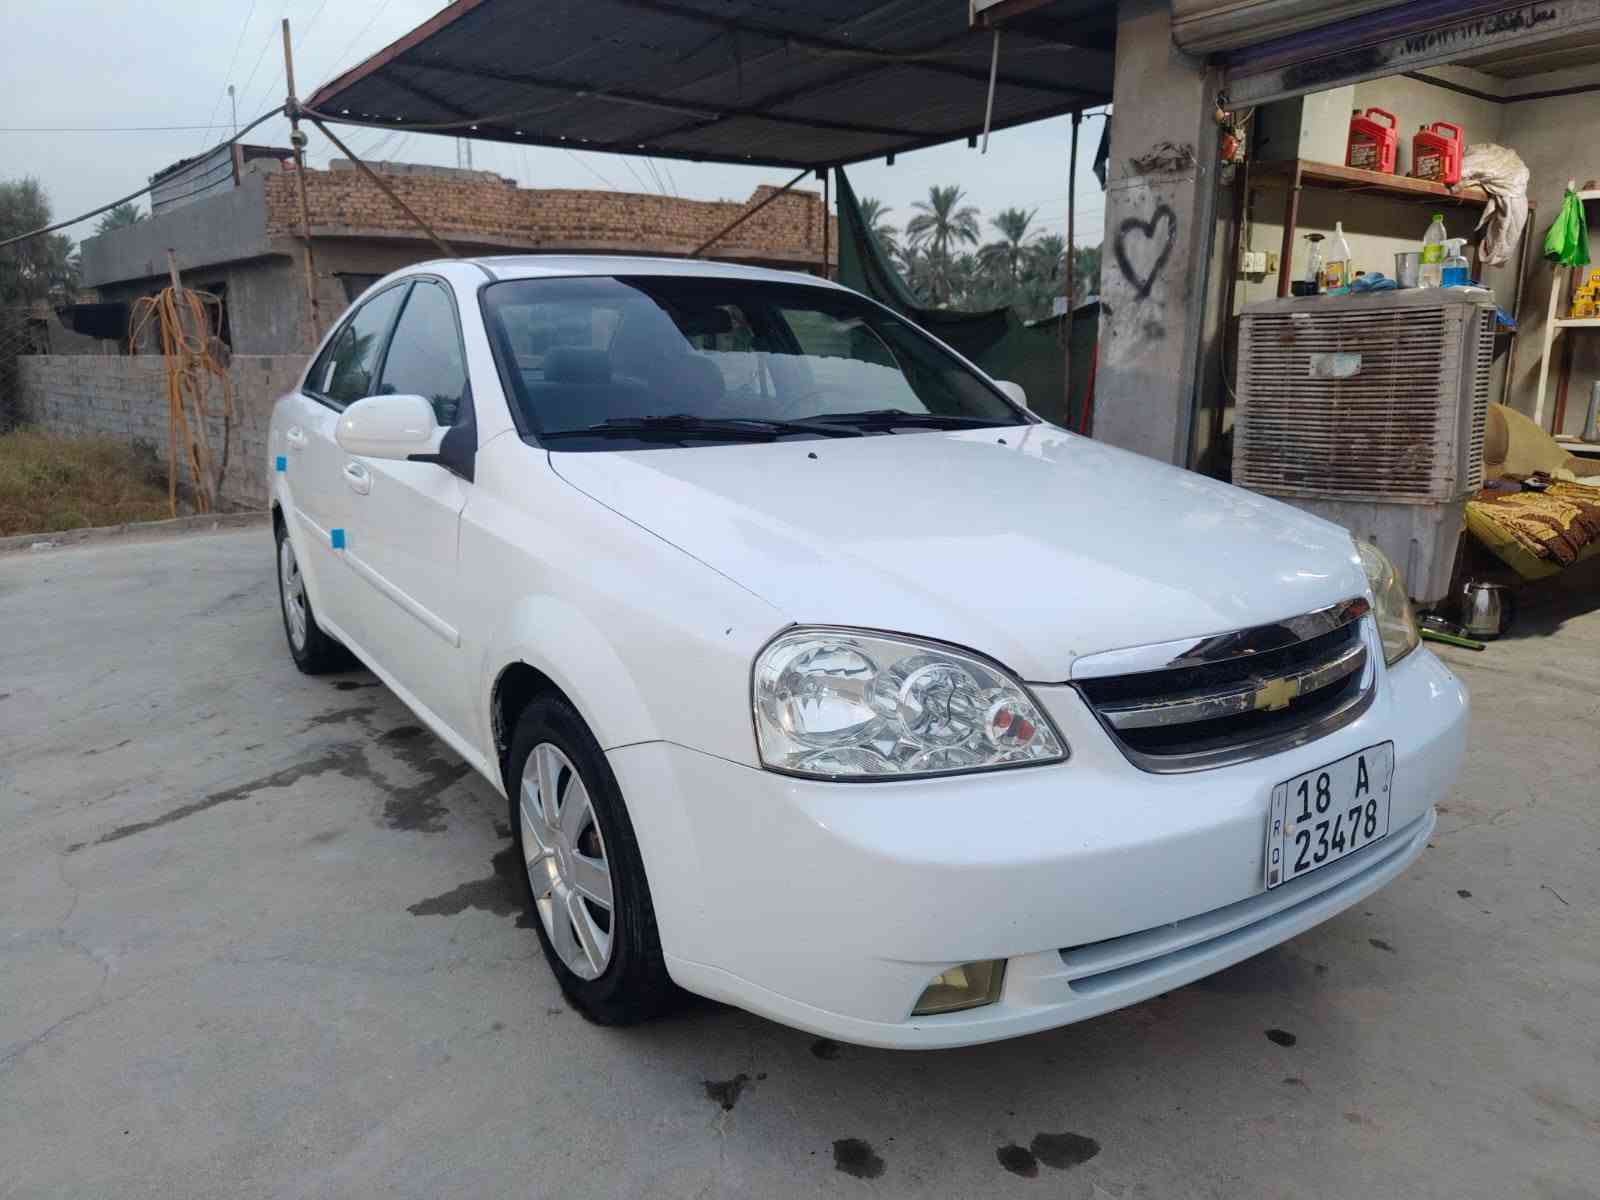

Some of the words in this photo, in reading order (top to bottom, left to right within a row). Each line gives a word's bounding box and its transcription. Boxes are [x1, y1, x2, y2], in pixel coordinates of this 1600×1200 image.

[1296, 772, 1331, 824] 18
[1355, 755, 1369, 798] A
[1294, 798, 1377, 873] 23478
